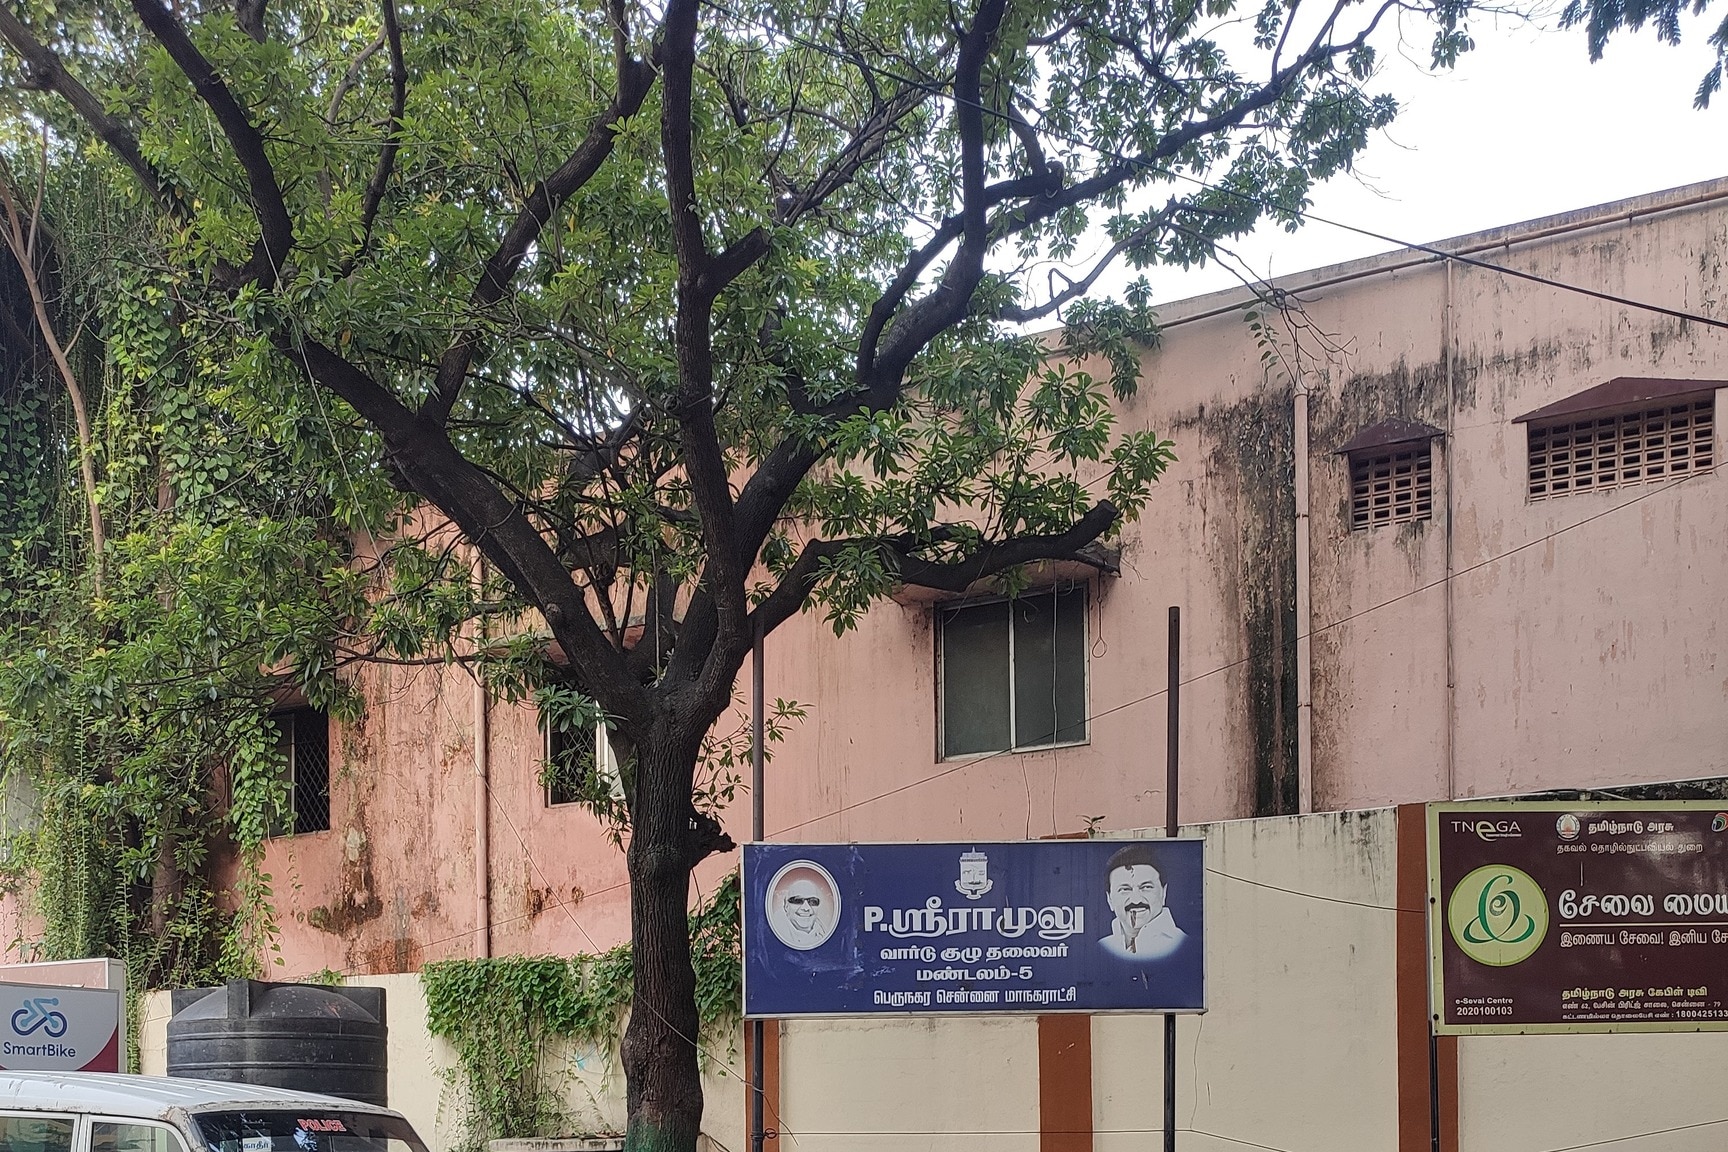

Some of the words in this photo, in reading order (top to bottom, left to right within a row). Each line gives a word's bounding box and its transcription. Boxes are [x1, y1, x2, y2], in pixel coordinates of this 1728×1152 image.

[1451, 821, 1521, 841] TNeGA
[1588, 820, 1643, 835] தமிழ்நாடு
[1647, 821, 1674, 833] அரசு
[1557, 843, 1587, 854] தகவல்
[1678, 844, 1703, 853] துறை
[1558, 889, 1655, 919] சேவை
[1560, 932, 1615, 947] இணைய
[1619, 930, 1664, 945] சேவை!
[1669, 929, 1707, 946] இனிய
[880, 945, 936, 962] வார்டு
[940, 946, 982, 963] குழு
[986, 943, 1068, 961] தலைவர்
[916, 965, 1033, 981] மண்டலம்-5
[874, 990, 931, 1006] பெருநகர
[936, 987, 999, 1004] சென்னை
[1005, 987, 1076, 1004] மாநகராட்சி
[1562, 987, 1615, 1000] தமிழ்நாடு
[1618, 989, 1644, 999] அரசு
[1648, 986, 1684, 997] கேபிள்
[1687, 986, 1707, 996] டிவி
[1457, 1006, 1513, 1015] 2020100103
[3, 1041, 76, 1057] SmartBike
[297, 1118, 346, 1132] POLICE
